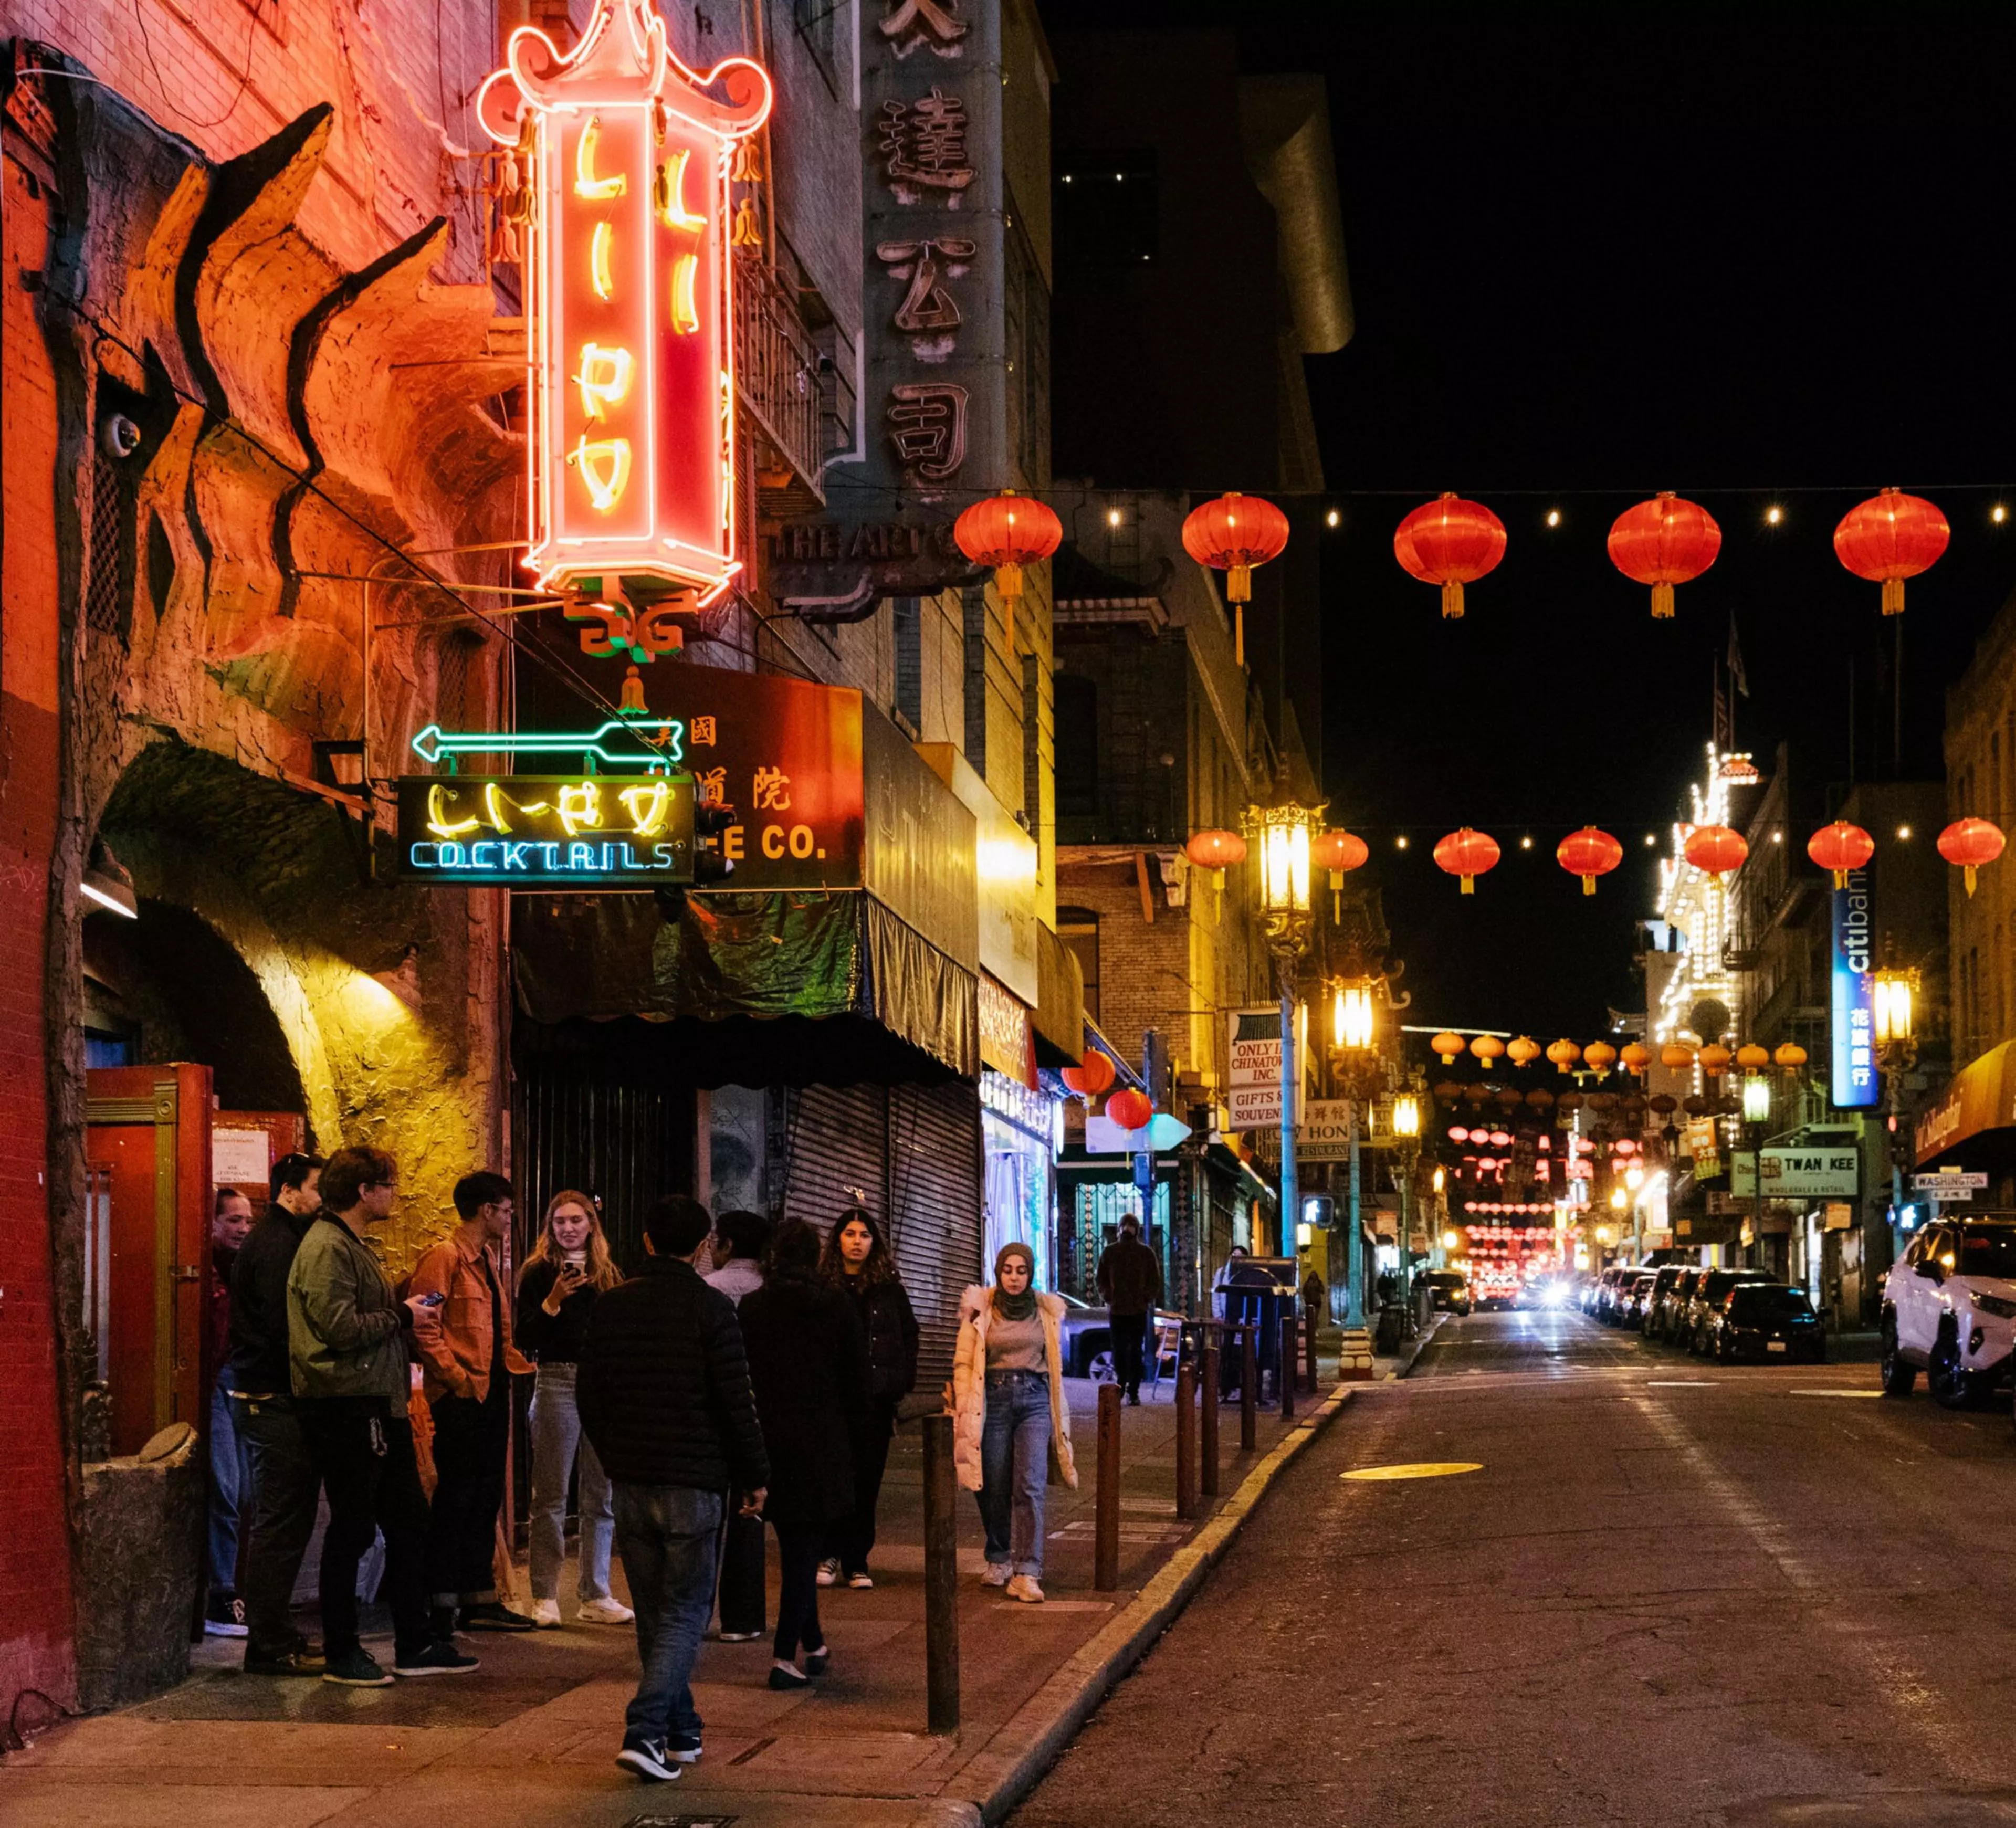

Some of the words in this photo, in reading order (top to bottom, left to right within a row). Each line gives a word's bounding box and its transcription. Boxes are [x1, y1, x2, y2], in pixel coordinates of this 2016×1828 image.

[761, 824, 826, 859] CO.
[411, 841, 674, 870] COCKTAILS
[1237, 1043, 1273, 1056] ONLY
[1232, 1055, 1283, 1070] CHINATO
[1253, 1069, 1276, 1081] INC.
[1236, 1092, 1274, 1106] GIFTS
[1234, 1108, 1283, 1121] SOUVEN
[1309, 1125, 1348, 1139] HON
[1784, 1157, 1822, 1171] TWAN
[1830, 1158, 1855, 1171] KEE
[1918, 1176, 1984, 1186] WASHINGTON
